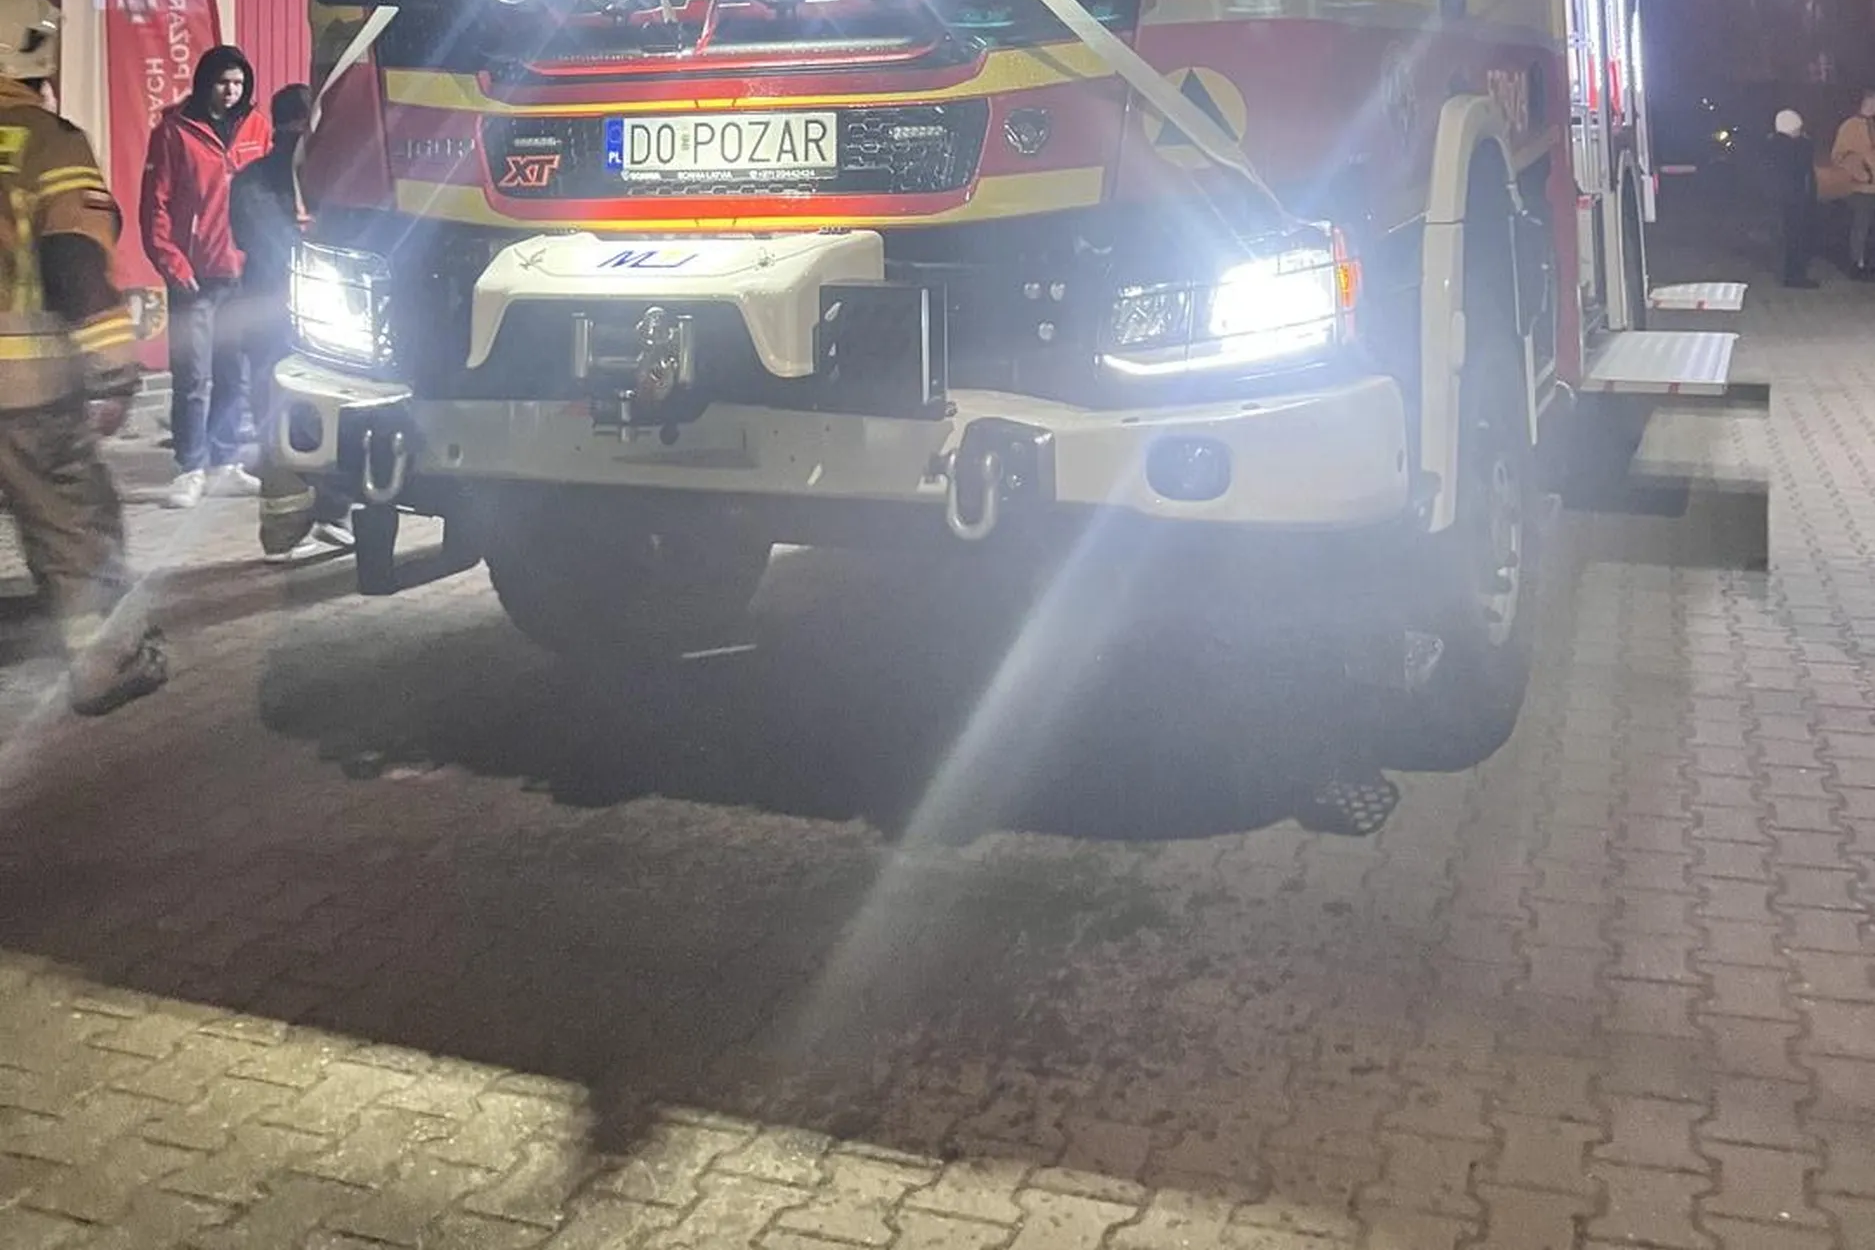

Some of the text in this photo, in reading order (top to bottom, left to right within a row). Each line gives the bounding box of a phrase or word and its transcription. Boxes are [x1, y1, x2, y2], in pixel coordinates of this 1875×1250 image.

[608, 151, 622, 164] PL
[694, 120, 828, 164] POZAR
[498, 155, 560, 187] XT
